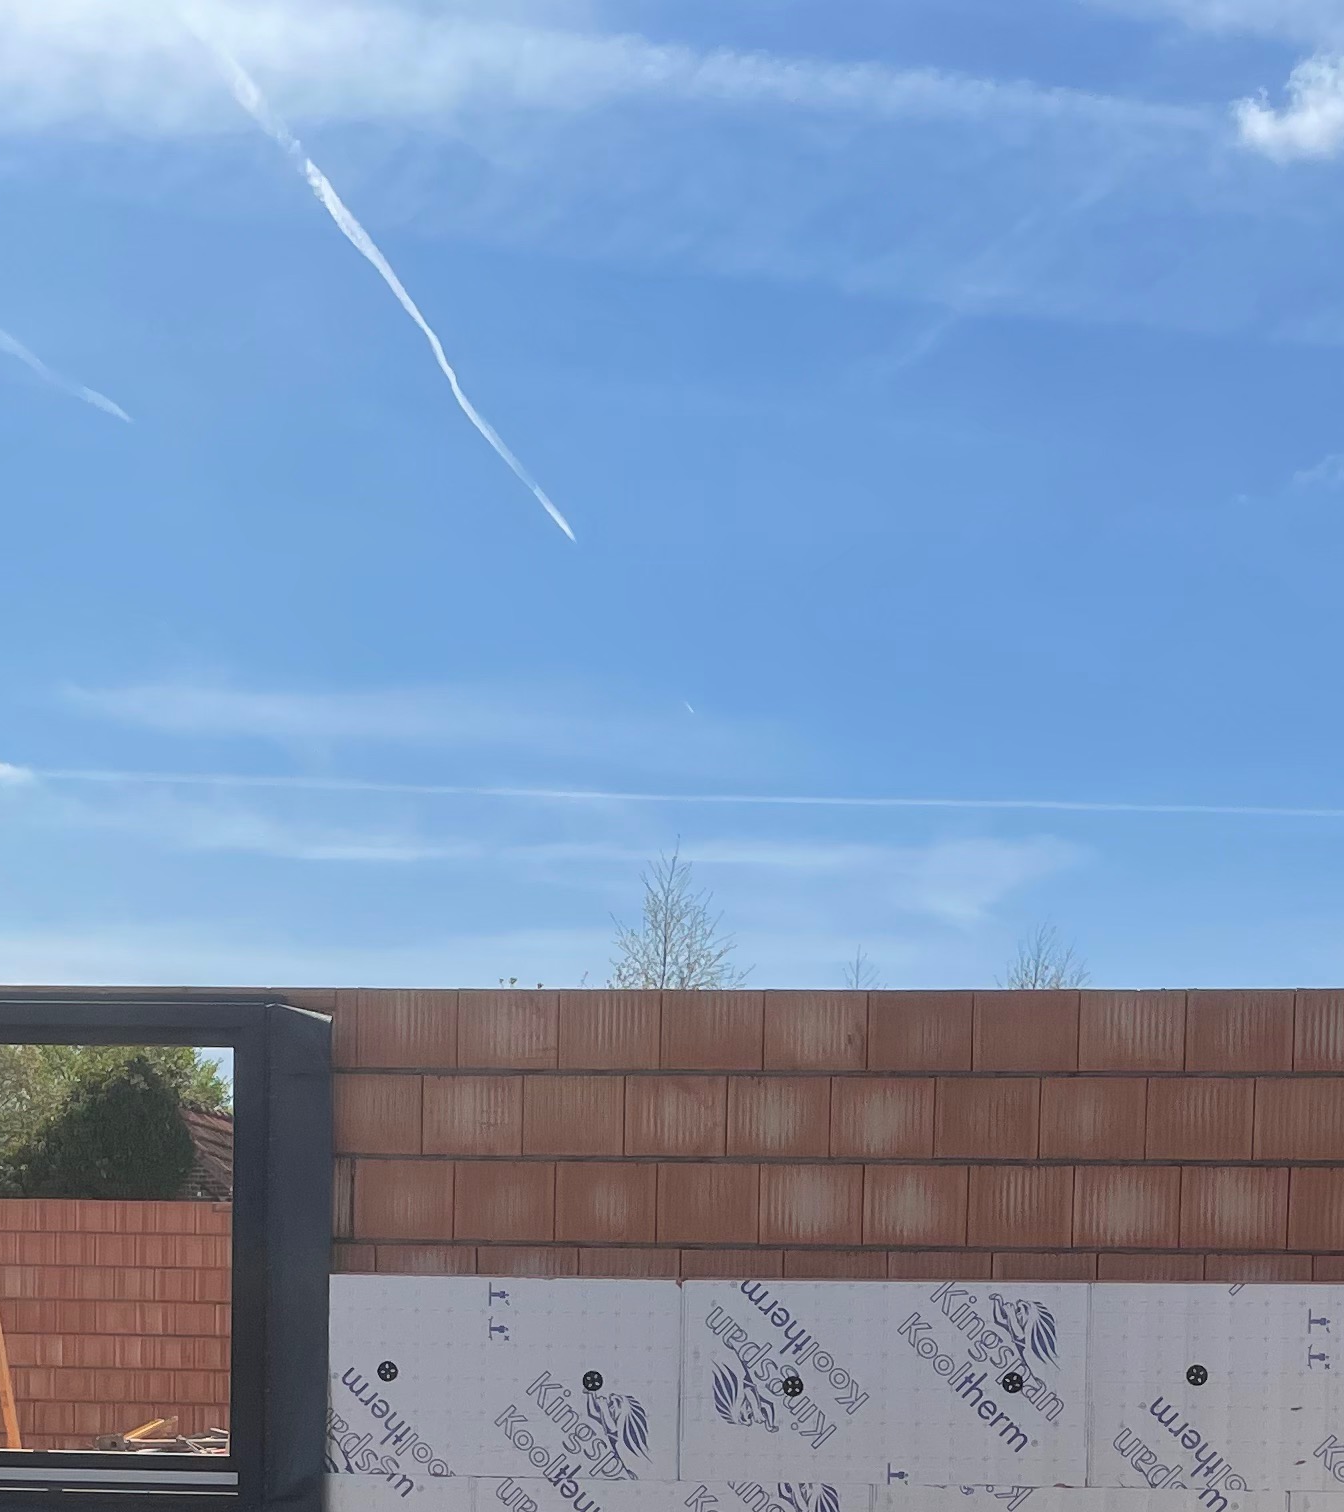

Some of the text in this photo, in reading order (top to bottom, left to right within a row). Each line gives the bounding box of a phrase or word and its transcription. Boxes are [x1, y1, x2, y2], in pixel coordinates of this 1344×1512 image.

[342, 1367, 455, 1476] ooltherm
[526, 1371, 625, 1480] Kingsp
[897, 1312, 1028, 1453] Kooltherm
[1150, 1397, 1248, 1491] oltherm
